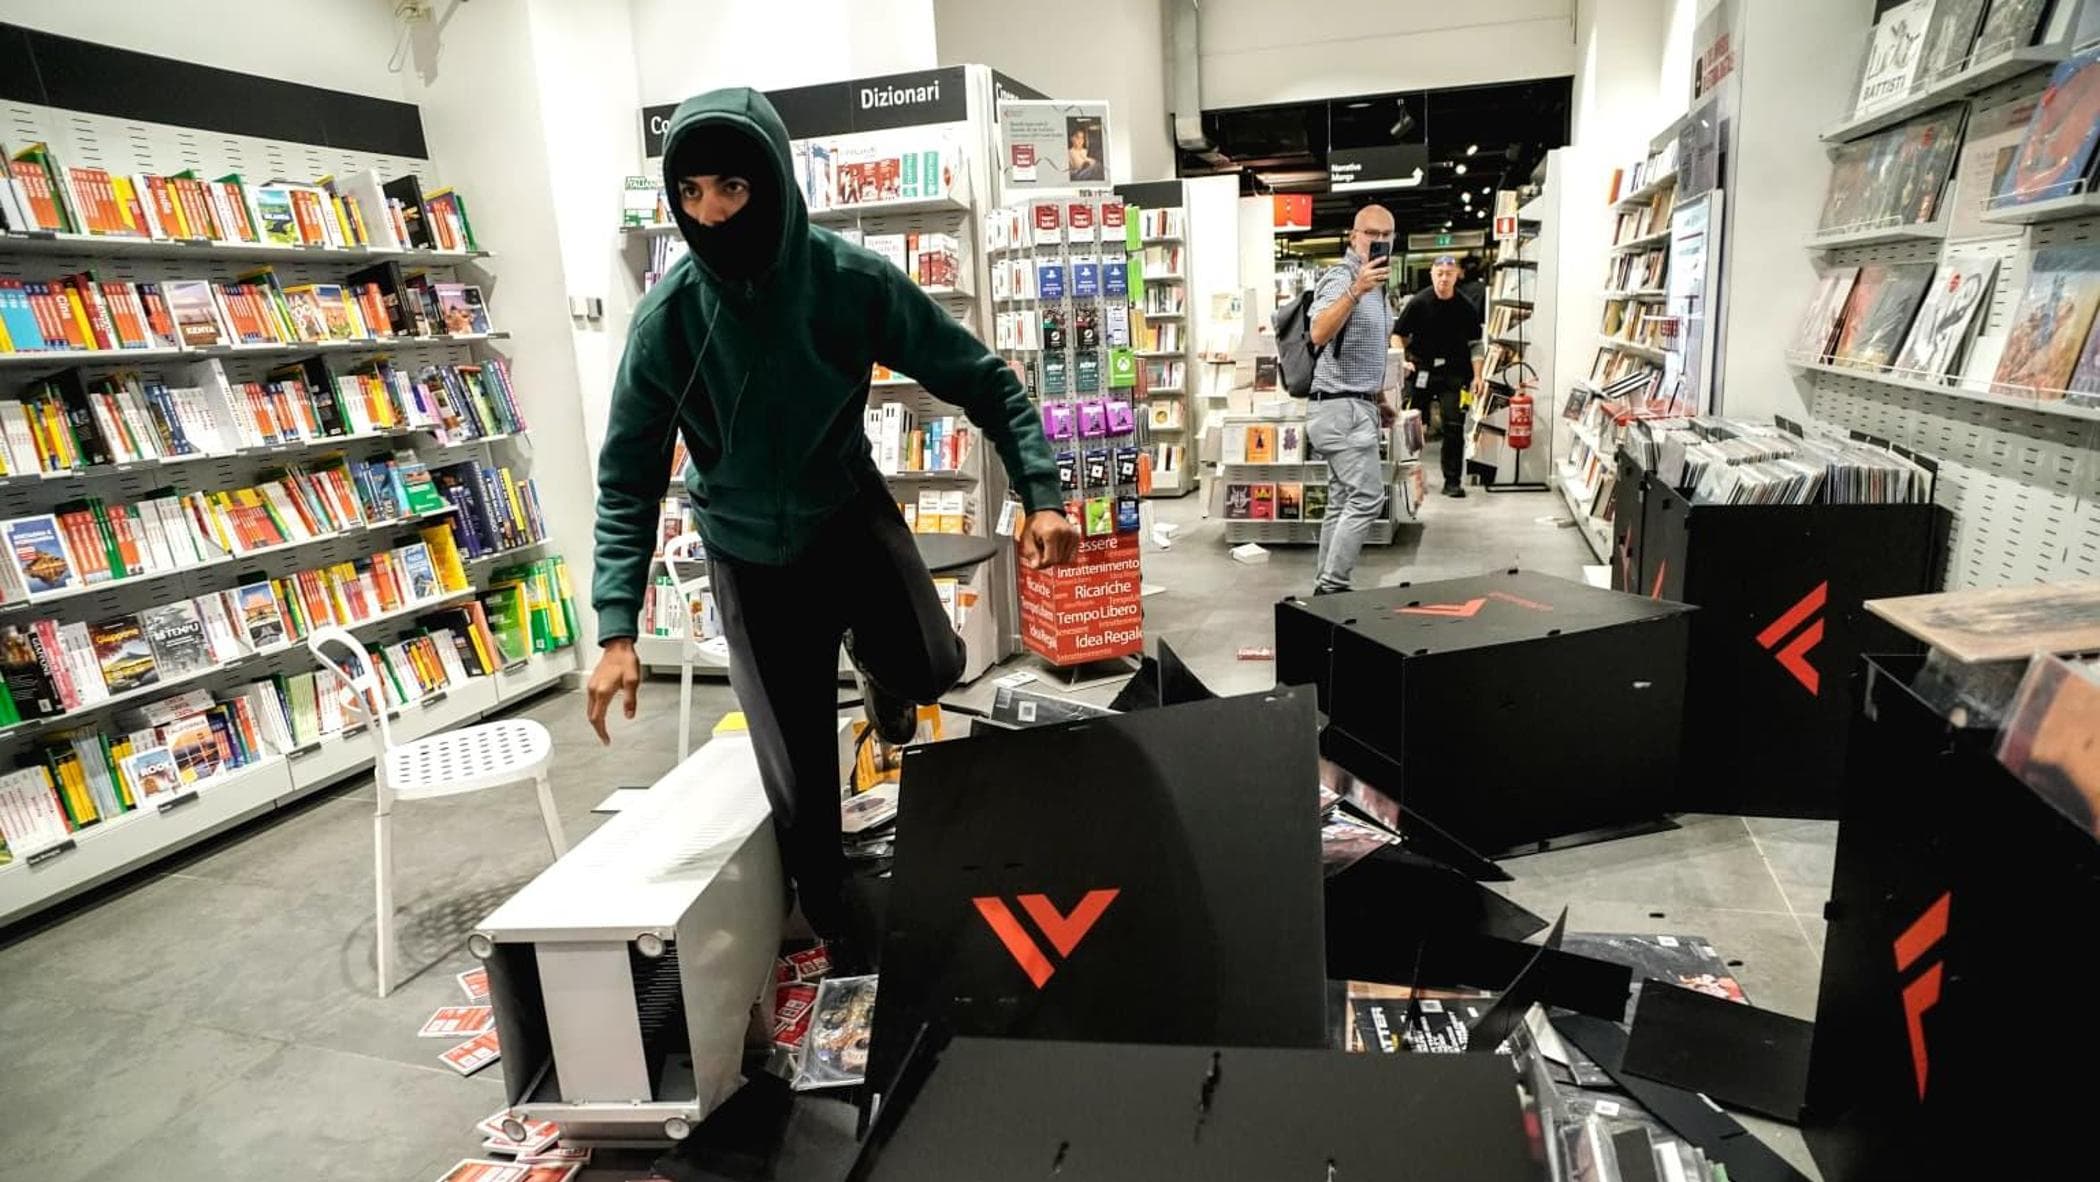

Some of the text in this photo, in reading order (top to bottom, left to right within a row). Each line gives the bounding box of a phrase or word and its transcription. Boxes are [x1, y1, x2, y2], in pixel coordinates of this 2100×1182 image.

[860, 80, 940, 110] Dizionari
[651, 114, 670, 135] Co
[1079, 537, 1118, 553] essere
[1057, 559, 1140, 579] Intrattenimento
[1075, 580, 1132, 599] Ricariche
[1057, 610, 1100, 625] Tempo
[1100, 604, 1137, 619] Libero
[95, 627, 140, 645] Giappone
[1076, 634, 1103, 649] Idea
